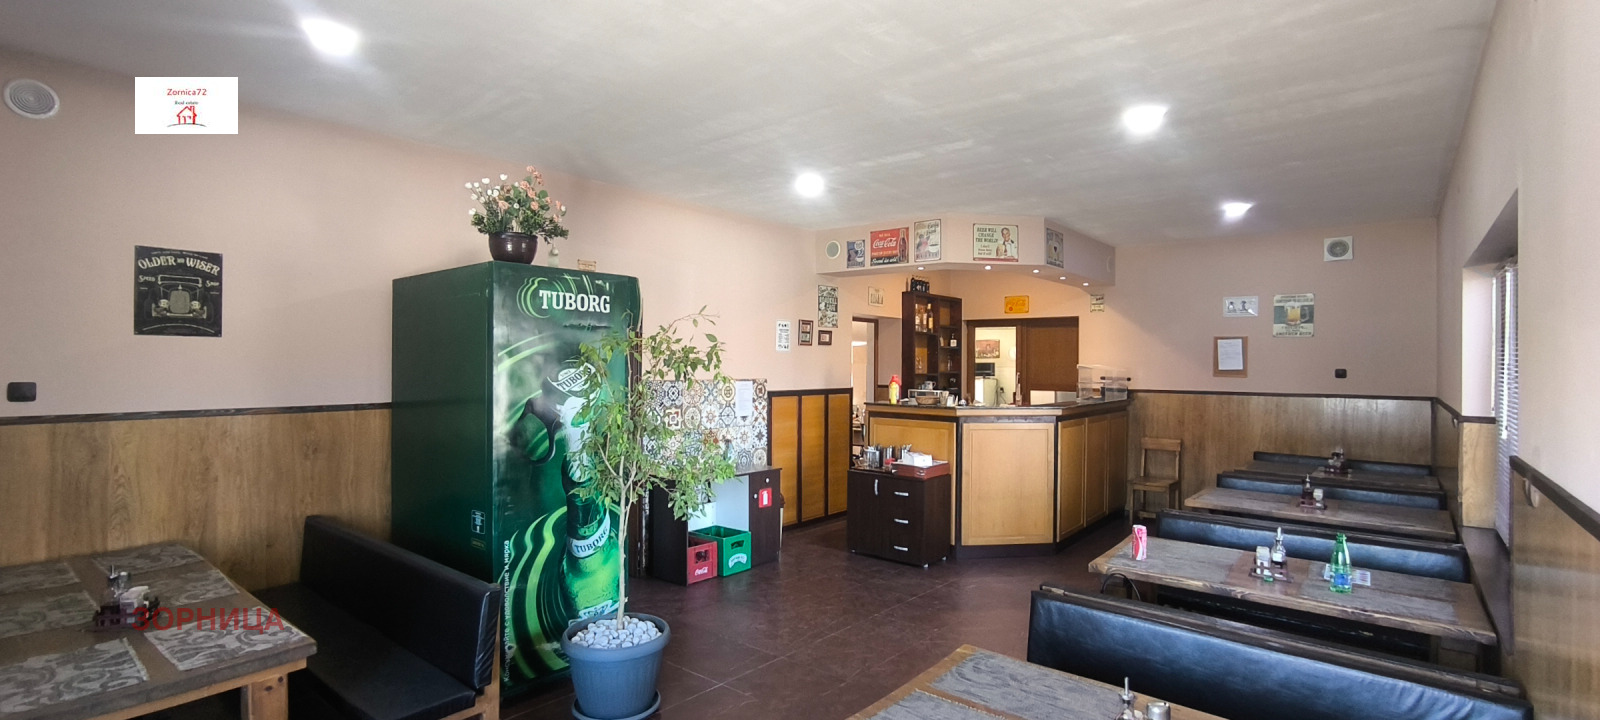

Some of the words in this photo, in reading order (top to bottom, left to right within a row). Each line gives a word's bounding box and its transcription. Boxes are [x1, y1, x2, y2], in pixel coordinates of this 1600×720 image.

[138, 255, 176, 269] OLDER
[185, 257, 220, 276] WISER
[539, 289, 611, 314] TUBORG
[574, 526, 608, 554] TUBORG
